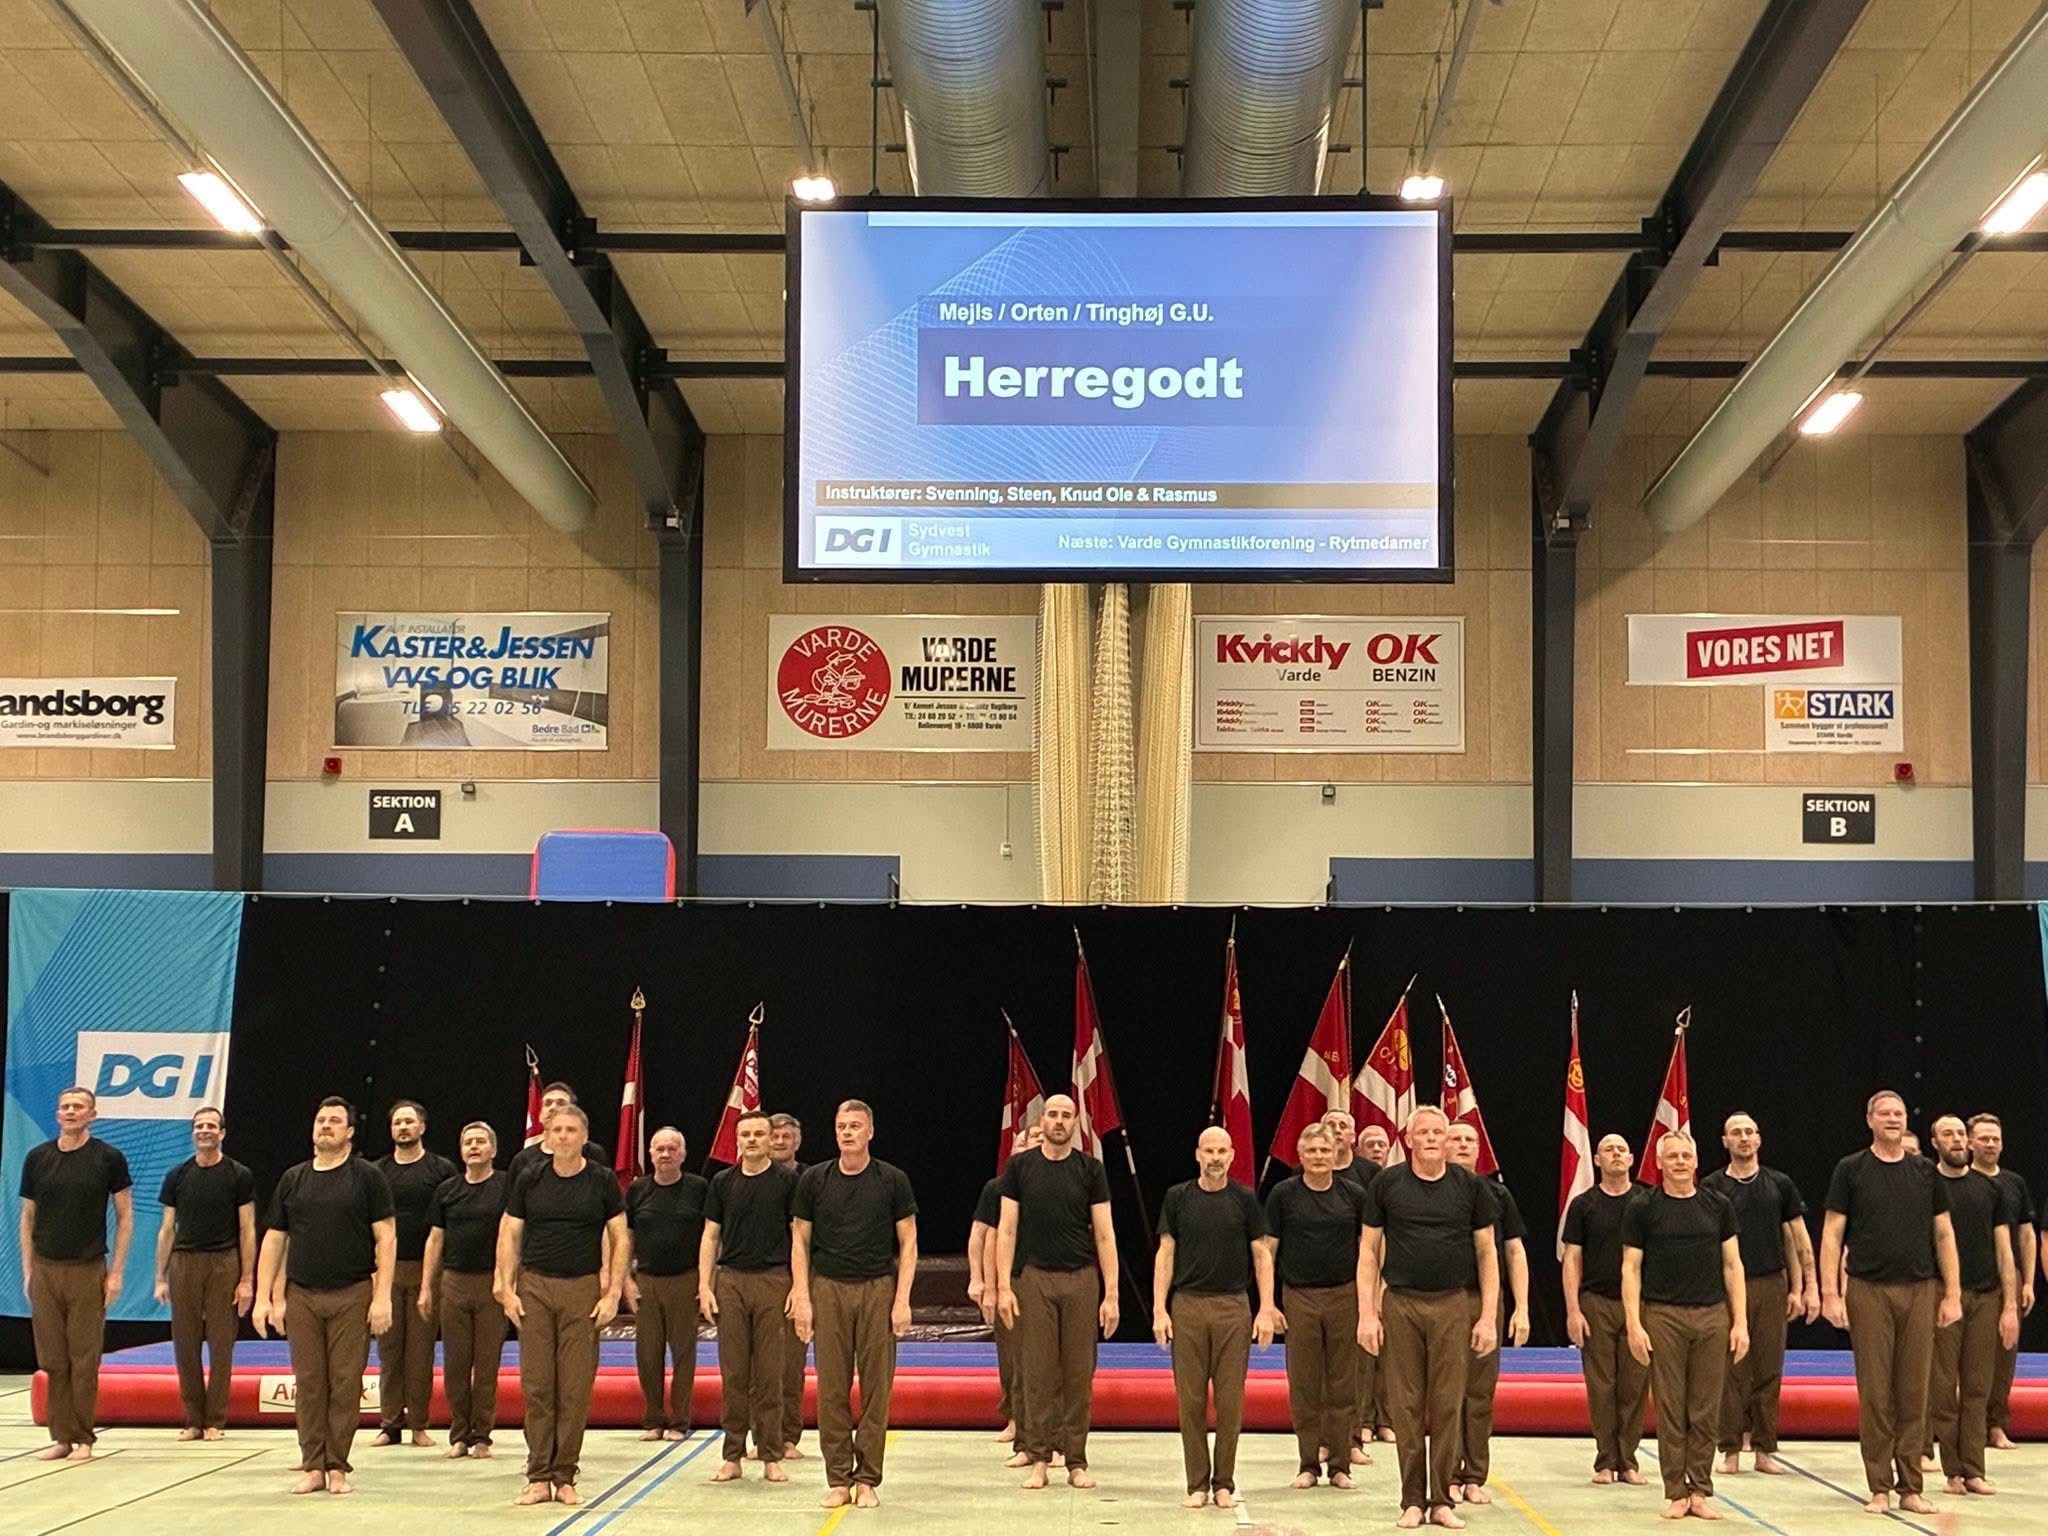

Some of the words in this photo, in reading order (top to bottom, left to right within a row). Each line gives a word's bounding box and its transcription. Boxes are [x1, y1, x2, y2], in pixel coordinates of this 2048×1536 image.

[939, 303, 993, 325] Mejls
[1011, 304, 1068, 321] Orten
[1086, 303, 1163, 326] Tinghøj
[1170, 303, 1214, 321] G.U.
[944, 356, 1244, 408] Herregodt
[826, 485, 922, 501] Instruktører:
[925, 486, 1004, 504] Svenning,
[1007, 487, 1057, 504] Steen,
[1061, 487, 1102, 502] Knud
[1106, 487, 1133, 502] Ole
[1136, 488, 1149, 502] &
[1153, 488, 1217, 503] Rasmus
[825, 527, 891, 553] DGI
[909, 522, 970, 539] Sydvest
[909, 543, 991, 558] Gymnastik
[1058, 535, 1113, 550] Næste:
[1117, 535, 1162, 551] Varde
[1167, 535, 1315, 554] Gymnastikforening
[1329, 535, 1429, 554] Rytmedamer
[793, 628, 878, 662] VARDE
[922, 637, 997, 663] VARDE
[1217, 634, 1351, 670] Kvickly
[1367, 634, 1441, 664] OK
[1697, 635, 1781, 668] VORES
[1787, 631, 1834, 662] NET
[383, 666, 441, 690] VVS
[446, 666, 493, 690] OG
[501, 666, 562, 690] BLIK
[902, 666, 1016, 692] MURERNE
[1277, 669, 1321, 682] Varde
[1373, 669, 1436, 682] BENZIN
[466, 701, 488, 715] 22
[494, 702, 515, 715] 02
[521, 702, 542, 715] 56
[782, 687, 887, 736] MURERNE
[1810, 692, 1891, 717] STARK
[1, 720, 50, 730] Gardin-og
[53, 720, 137, 730] markiseløsninger
[532, 724, 560, 734] Bedre
[561, 724, 580, 734] Bad
[373, 796, 436, 809] SEKTION
[1806, 800, 1870, 813] SEKTION
[394, 813, 415, 833] A
[1831, 817, 1847, 837] B
[95, 1053, 214, 1099] DGI
